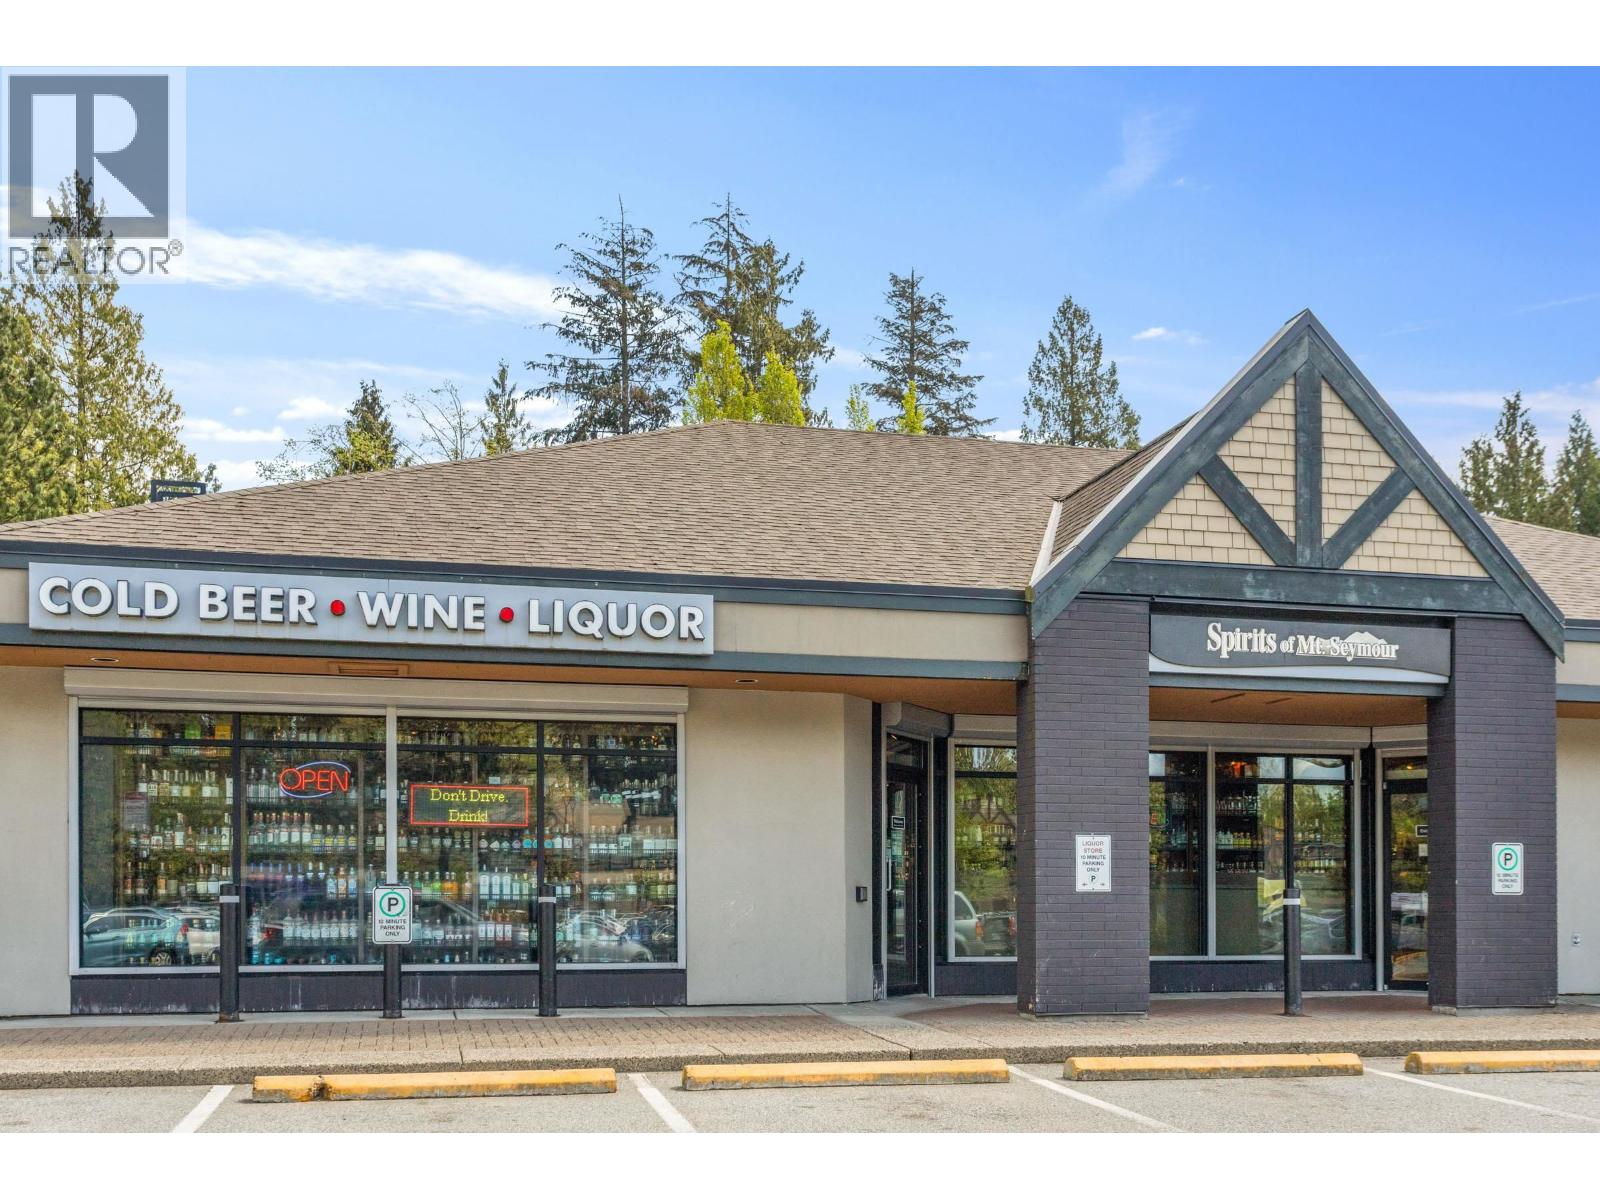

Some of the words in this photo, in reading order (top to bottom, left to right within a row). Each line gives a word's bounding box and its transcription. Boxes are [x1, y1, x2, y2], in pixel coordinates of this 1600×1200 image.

[38, 576, 179, 618] COLD
[199, 583, 318, 626] BEER
[357, 590, 487, 631] WINE
[528, 598, 705, 641] LIQUOR
[1207, 622, 1277, 659] Spirits
[1280, 636, 1296, 654] of
[1297, 634, 1326, 656] Mt.
[1330, 636, 1399, 662] Seymour
[279, 767, 350, 792] OPEN
[430, 788, 468, 802] Don't
[1504, 852, 1513, 866] P
[387, 897, 399, 912] P
